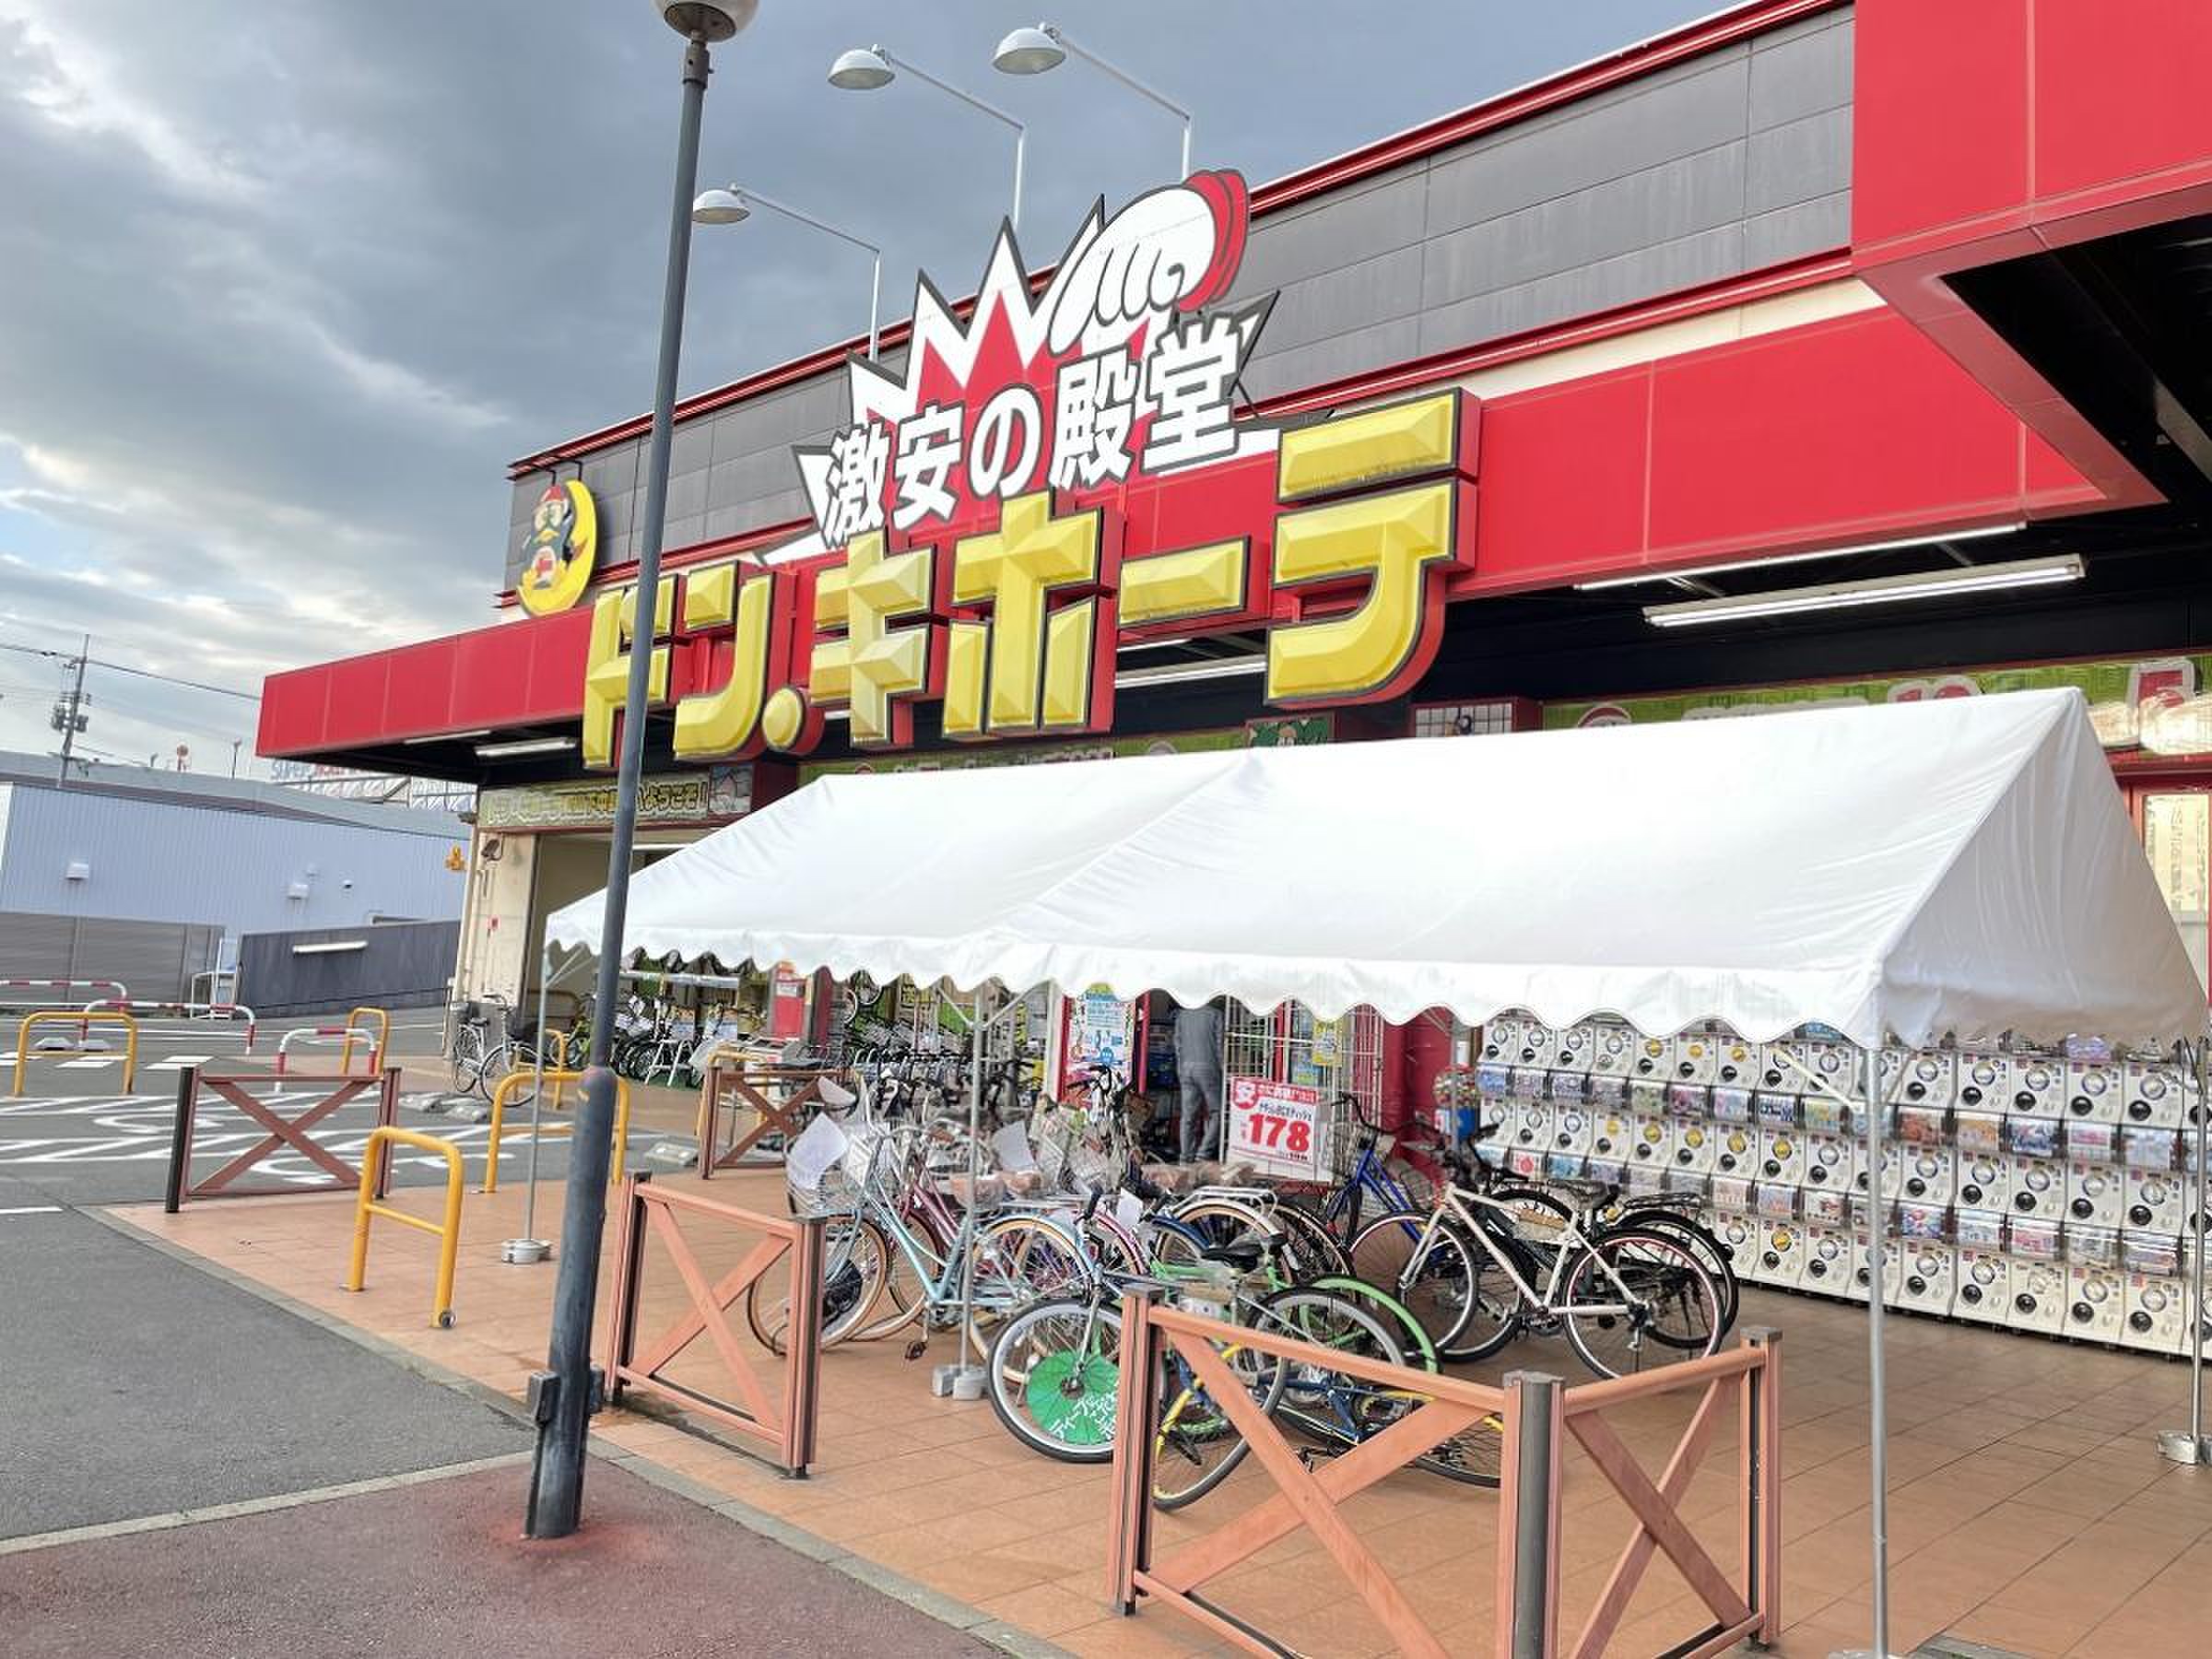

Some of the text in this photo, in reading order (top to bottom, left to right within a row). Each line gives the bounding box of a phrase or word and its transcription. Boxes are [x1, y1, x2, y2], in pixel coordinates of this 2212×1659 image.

[826, 318, 1239, 547] 激安の殿堂
[1249, 1113, 1310, 1151] 178
